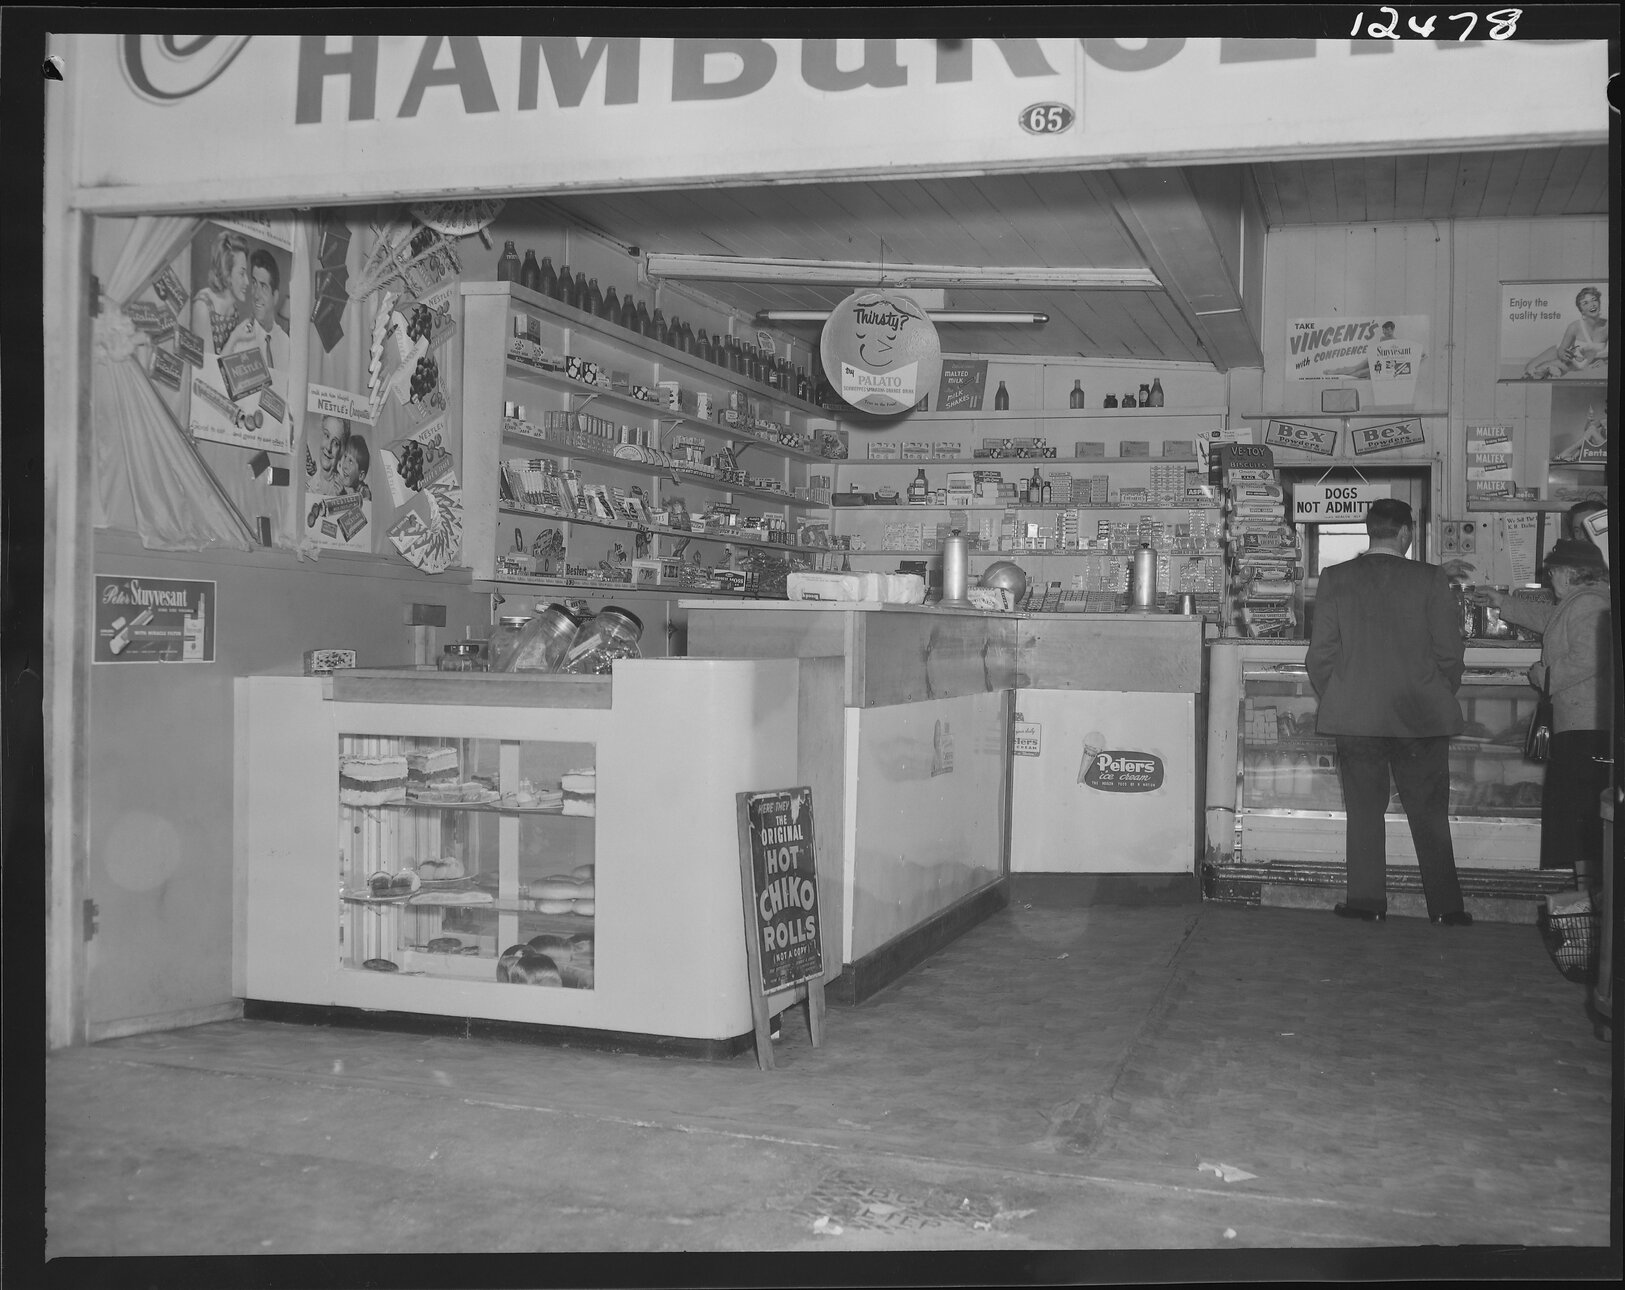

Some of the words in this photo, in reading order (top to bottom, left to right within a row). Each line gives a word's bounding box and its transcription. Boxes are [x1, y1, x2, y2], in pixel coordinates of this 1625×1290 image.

[1029, 107, 1064, 133] 65
[1509, 297, 1533, 309] Enjoy
[1535, 297, 1549, 308] the
[852, 308, 910, 332] Thirsty?
[1509, 311, 1538, 322] quality
[1540, 311, 1562, 320] taste
[1294, 322, 1315, 331] TAKE
[1290, 319, 1379, 356] VINCENT'S
[1295, 356, 1311, 370] with
[1313, 344, 1369, 364] CONFIDENCE
[944, 370, 969, 378] MALTED
[858, 375, 902, 388] PALATO
[945, 394, 970, 410] SHAKES
[1276, 423, 1327, 443] Bex
[1362, 423, 1413, 443] Bex
[1476, 427, 1506, 437] MALTEX
[1279, 436, 1320, 449] Powders
[1367, 435, 1411, 449] Powders
[1476, 454, 1505, 463] MALTEX
[1584, 448, 1607, 458] Fanta
[1476, 481, 1506, 491] MALTEX
[1325, 487, 1358, 500] DOGS
[1296, 501, 1321, 514] NOT
[1325, 501, 1374, 514] ADMITT
[566, 563, 588, 577] Besters
[102, 584, 131, 605] Peter
[130, 579, 188, 608] Stuyvesant
[1096, 753, 1156, 773] Peters
[1098, 770, 1115, 780] ice
[1119, 773, 1152, 782] cream
[758, 801, 775, 815] HERE
[775, 800, 790, 812] THEY
[776, 814, 788, 827] THE
[761, 825, 804, 848] ORIGINAL
[766, 845, 800, 875] HOT
[759, 875, 816, 923] CHIKO
[763, 915, 817, 953] ROLLS
